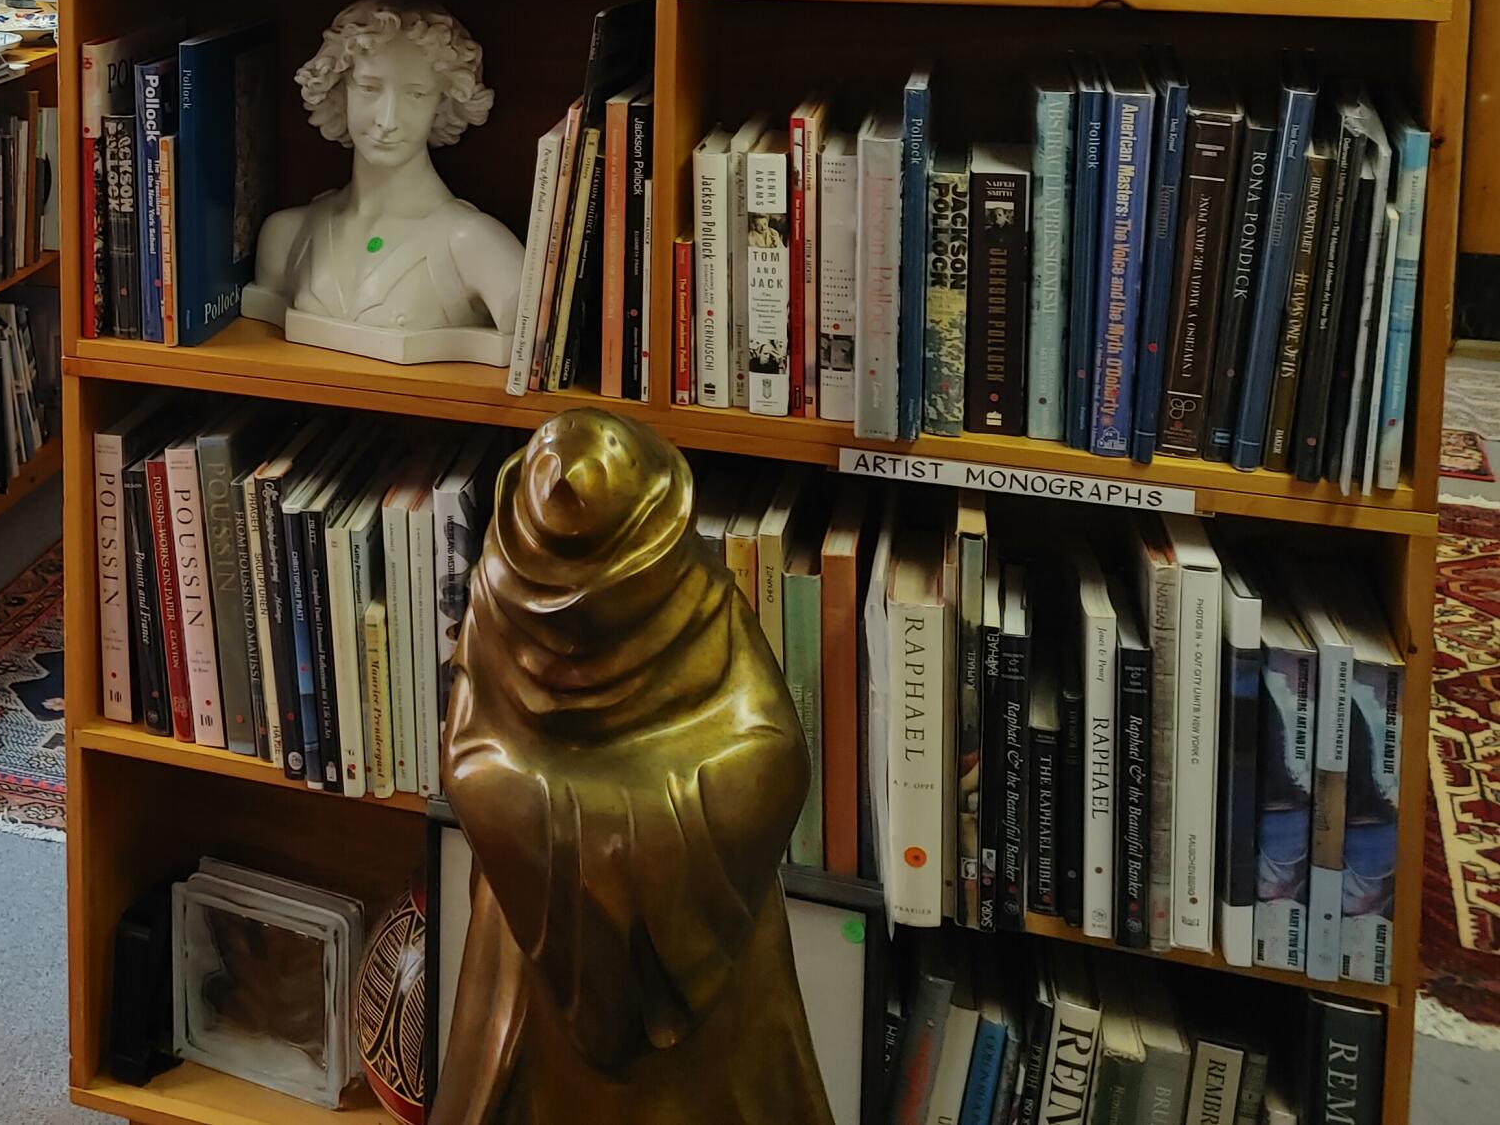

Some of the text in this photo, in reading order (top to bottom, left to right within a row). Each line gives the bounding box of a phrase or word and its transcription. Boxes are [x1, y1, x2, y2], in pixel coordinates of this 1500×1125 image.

[144, 75, 162, 142] Pollock
[182, 68, 193, 110] Pollock
[632, 117, 644, 196] Jackson Pollock
[910, 117, 924, 165] Pollock
[1087, 121, 1101, 169] Pollock
[701, 175, 717, 260] Jackson Pollock
[755, 169, 765, 207] ADAMS
[766, 170, 778, 206] HENRY
[1041, 98, 1065, 315] ABSTRACT EXPRESSIONISM
[1300, 176, 1323, 255] RIEN POORTVLIET
[931, 182, 949, 289] POLLOCK
[950, 183, 968, 290] JACKSON
[1233, 151, 1268, 300] RONA PONDICK
[678, 278, 688, 292] The
[750, 277, 784, 290] JACK
[752, 250, 781, 263] TOM
[756, 266, 777, 275] AND
[868, 177, 894, 342] Jackson Pollock
[1101, 103, 1140, 415] American Masters: The Voice and the Myth O'Doherty
[205, 286, 241, 326] Pollock
[987, 248, 1008, 383] JACKSON POLLOCK
[704, 317, 716, 371] CERNUSCHI
[855, 454, 1164, 508] ARTIST MONOGRAPHS
[99, 471, 120, 608] POUSSIN
[207, 461, 238, 594] POUSSIN
[173, 488, 204, 628] POUSSIN
[291, 551, 305, 621] CHRISTOPHER PRATT
[135, 550, 152, 645] Poussin and France
[234, 510, 261, 684] FROM POUSSIN TO MATISSE
[986, 631, 999, 677] RAPHAEL
[369, 658, 386, 779] Maurice Prendergast
[903, 616, 926, 763] RAPHAEL
[1006, 700, 1019, 747] Raphael
[1129, 715, 1145, 762] Raphael
[1334, 696, 1346, 761] RAUSCHENBERG
[1006, 771, 1019, 788] the
[1091, 717, 1111, 819] RAPHAEL
[1129, 785, 1143, 804] the
[1002, 789, 1020, 840] Beautiful
[1038, 754, 1053, 895] THE RAPHAEL BIBLE
[1126, 806, 1144, 858] Beautiful
[1004, 842, 1019, 882] Banker
[1127, 859, 1143, 898] Banker
[980, 898, 994, 928] SKIRA
